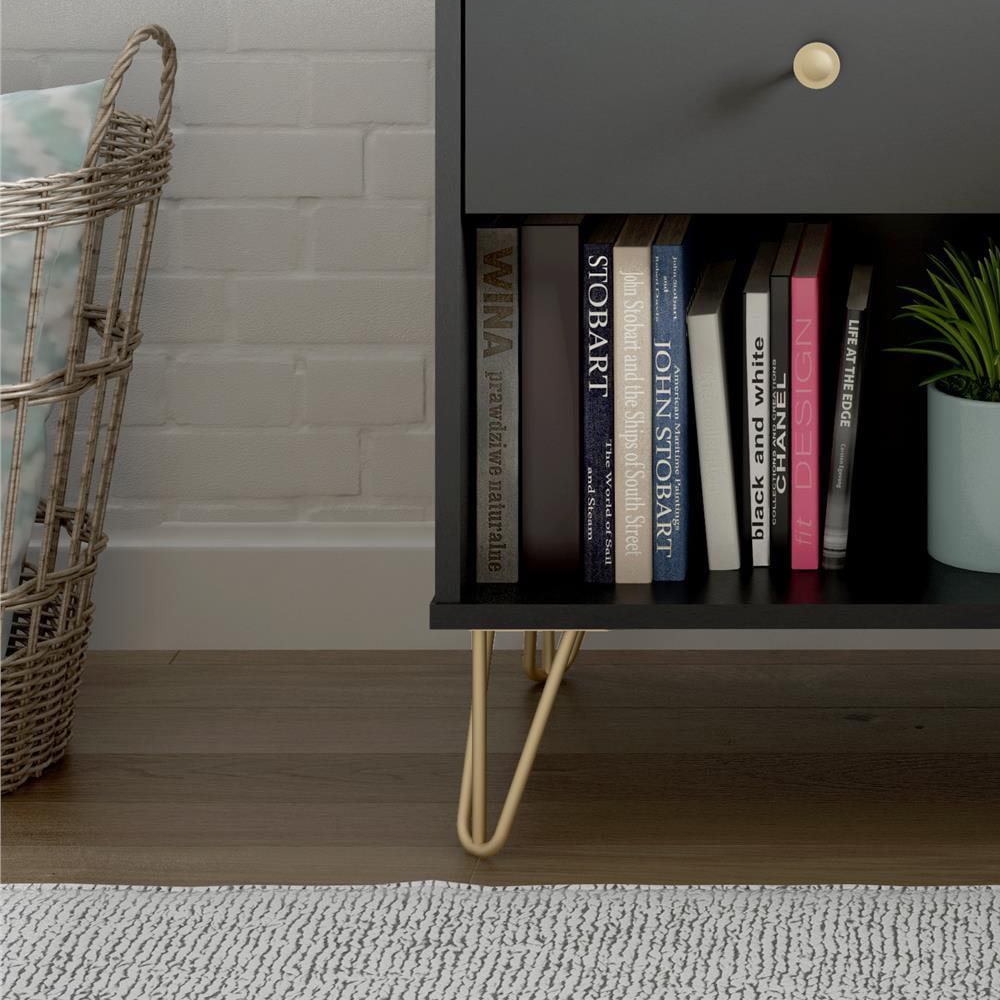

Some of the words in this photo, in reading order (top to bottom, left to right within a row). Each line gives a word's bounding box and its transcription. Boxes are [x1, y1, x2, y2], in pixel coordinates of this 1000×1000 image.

[483, 246, 513, 358] WINA
[620, 270, 645, 297] John
[587, 255, 609, 397] STOBART
[623, 299, 645, 352] Stobart
[846, 319, 860, 346] LIFE
[624, 353, 645, 381] and
[751, 336, 765, 407] white
[843, 366, 856, 391] THE
[845, 347, 858, 365] AT
[624, 382, 645, 408] the
[654, 340, 672, 419] JOHN
[673, 364, 681, 419] American
[485, 370, 508, 477] prawdziwe
[796, 318, 813, 489] DESIGN
[840, 394, 854, 428] EDGE
[619, 410, 645, 449] Ships
[751, 417, 765, 464] and
[776, 372, 787, 494] CHANEL
[604, 439, 613, 468] The
[624, 452, 646, 470] of
[587, 467, 596, 493] and
[604, 472, 613, 518] World
[624, 469, 646, 511] South
[655, 426, 672, 558] STOBART
[488, 479, 508, 573] naturalne
[587, 495, 596, 541] Steam
[672, 478, 681, 532] Paintings
[751, 475, 765, 540] black
[604, 521, 613, 536] of
[624, 514, 646, 556] Street
[604, 538, 613, 566] Sail
